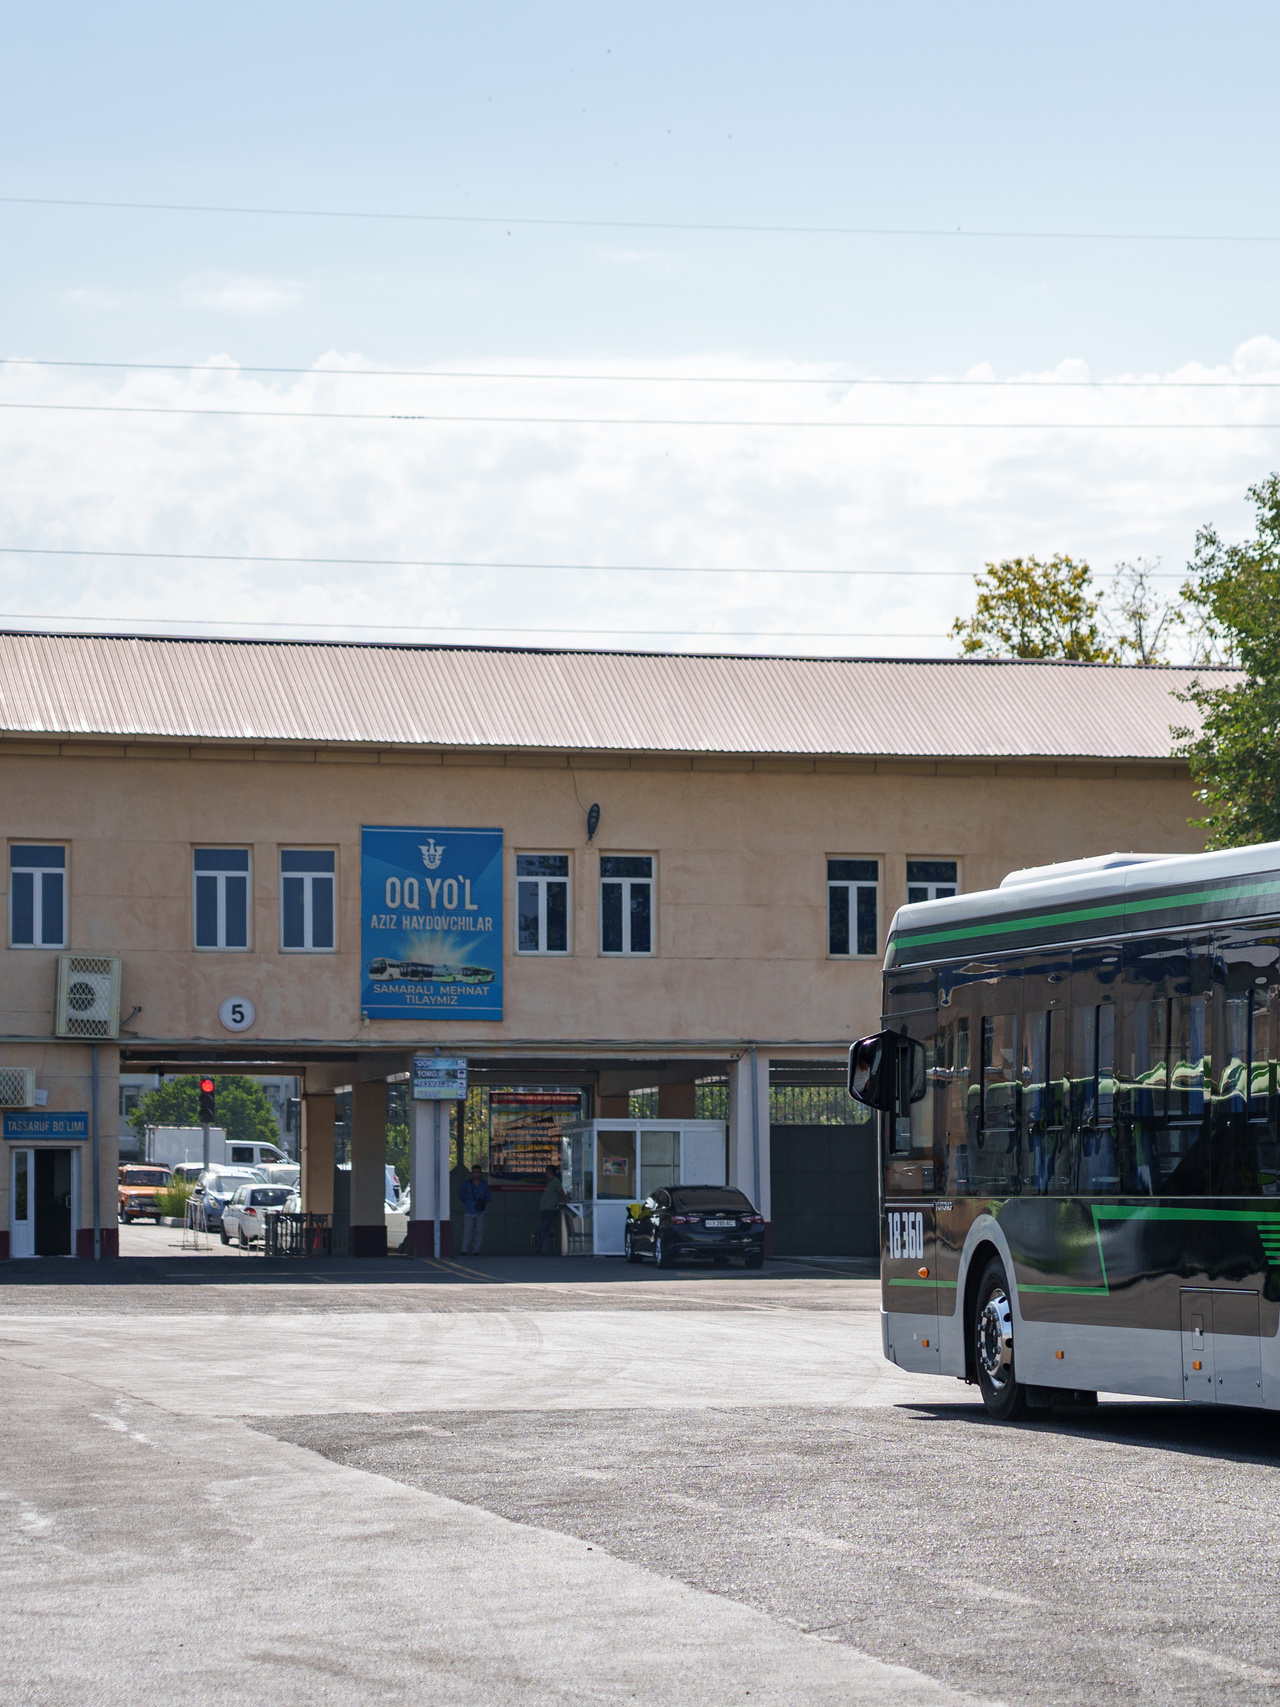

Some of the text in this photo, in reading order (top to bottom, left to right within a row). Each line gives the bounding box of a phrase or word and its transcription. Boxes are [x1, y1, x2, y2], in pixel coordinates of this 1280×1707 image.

[385, 876, 420, 911] OQ
[370, 914, 493, 932] AZIZ HAYDOVCHILAR
[373, 984, 490, 996] SAMARALI MEHNAT
[405, 995, 459, 1005] TILAYMIZ
[231, 1004, 245, 1024] 5
[7, 1120, 50, 1132] TASSARUF
